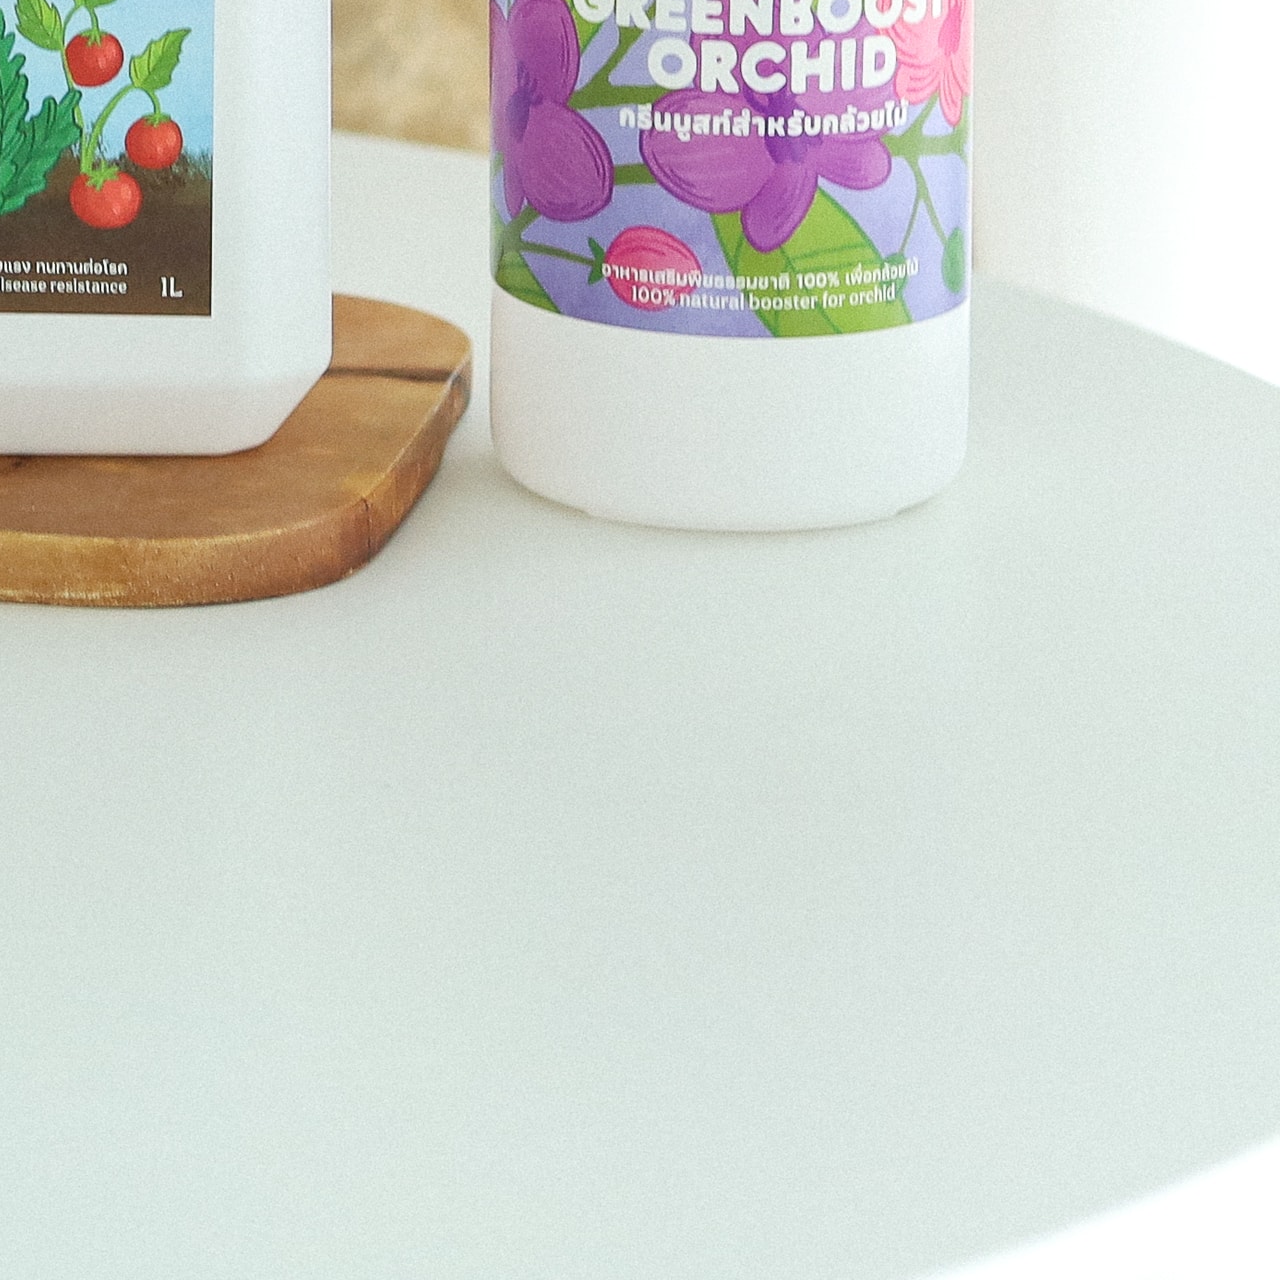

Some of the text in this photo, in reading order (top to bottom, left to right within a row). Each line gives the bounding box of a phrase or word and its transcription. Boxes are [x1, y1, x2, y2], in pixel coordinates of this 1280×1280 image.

[647, 36, 898, 95] ORCHID
[50, 278, 127, 294] resistance
[161, 276, 183, 298] 1L
[796, 271, 840, 289] 100%
[632, 282, 895, 311] 100% natural booster for orchid
